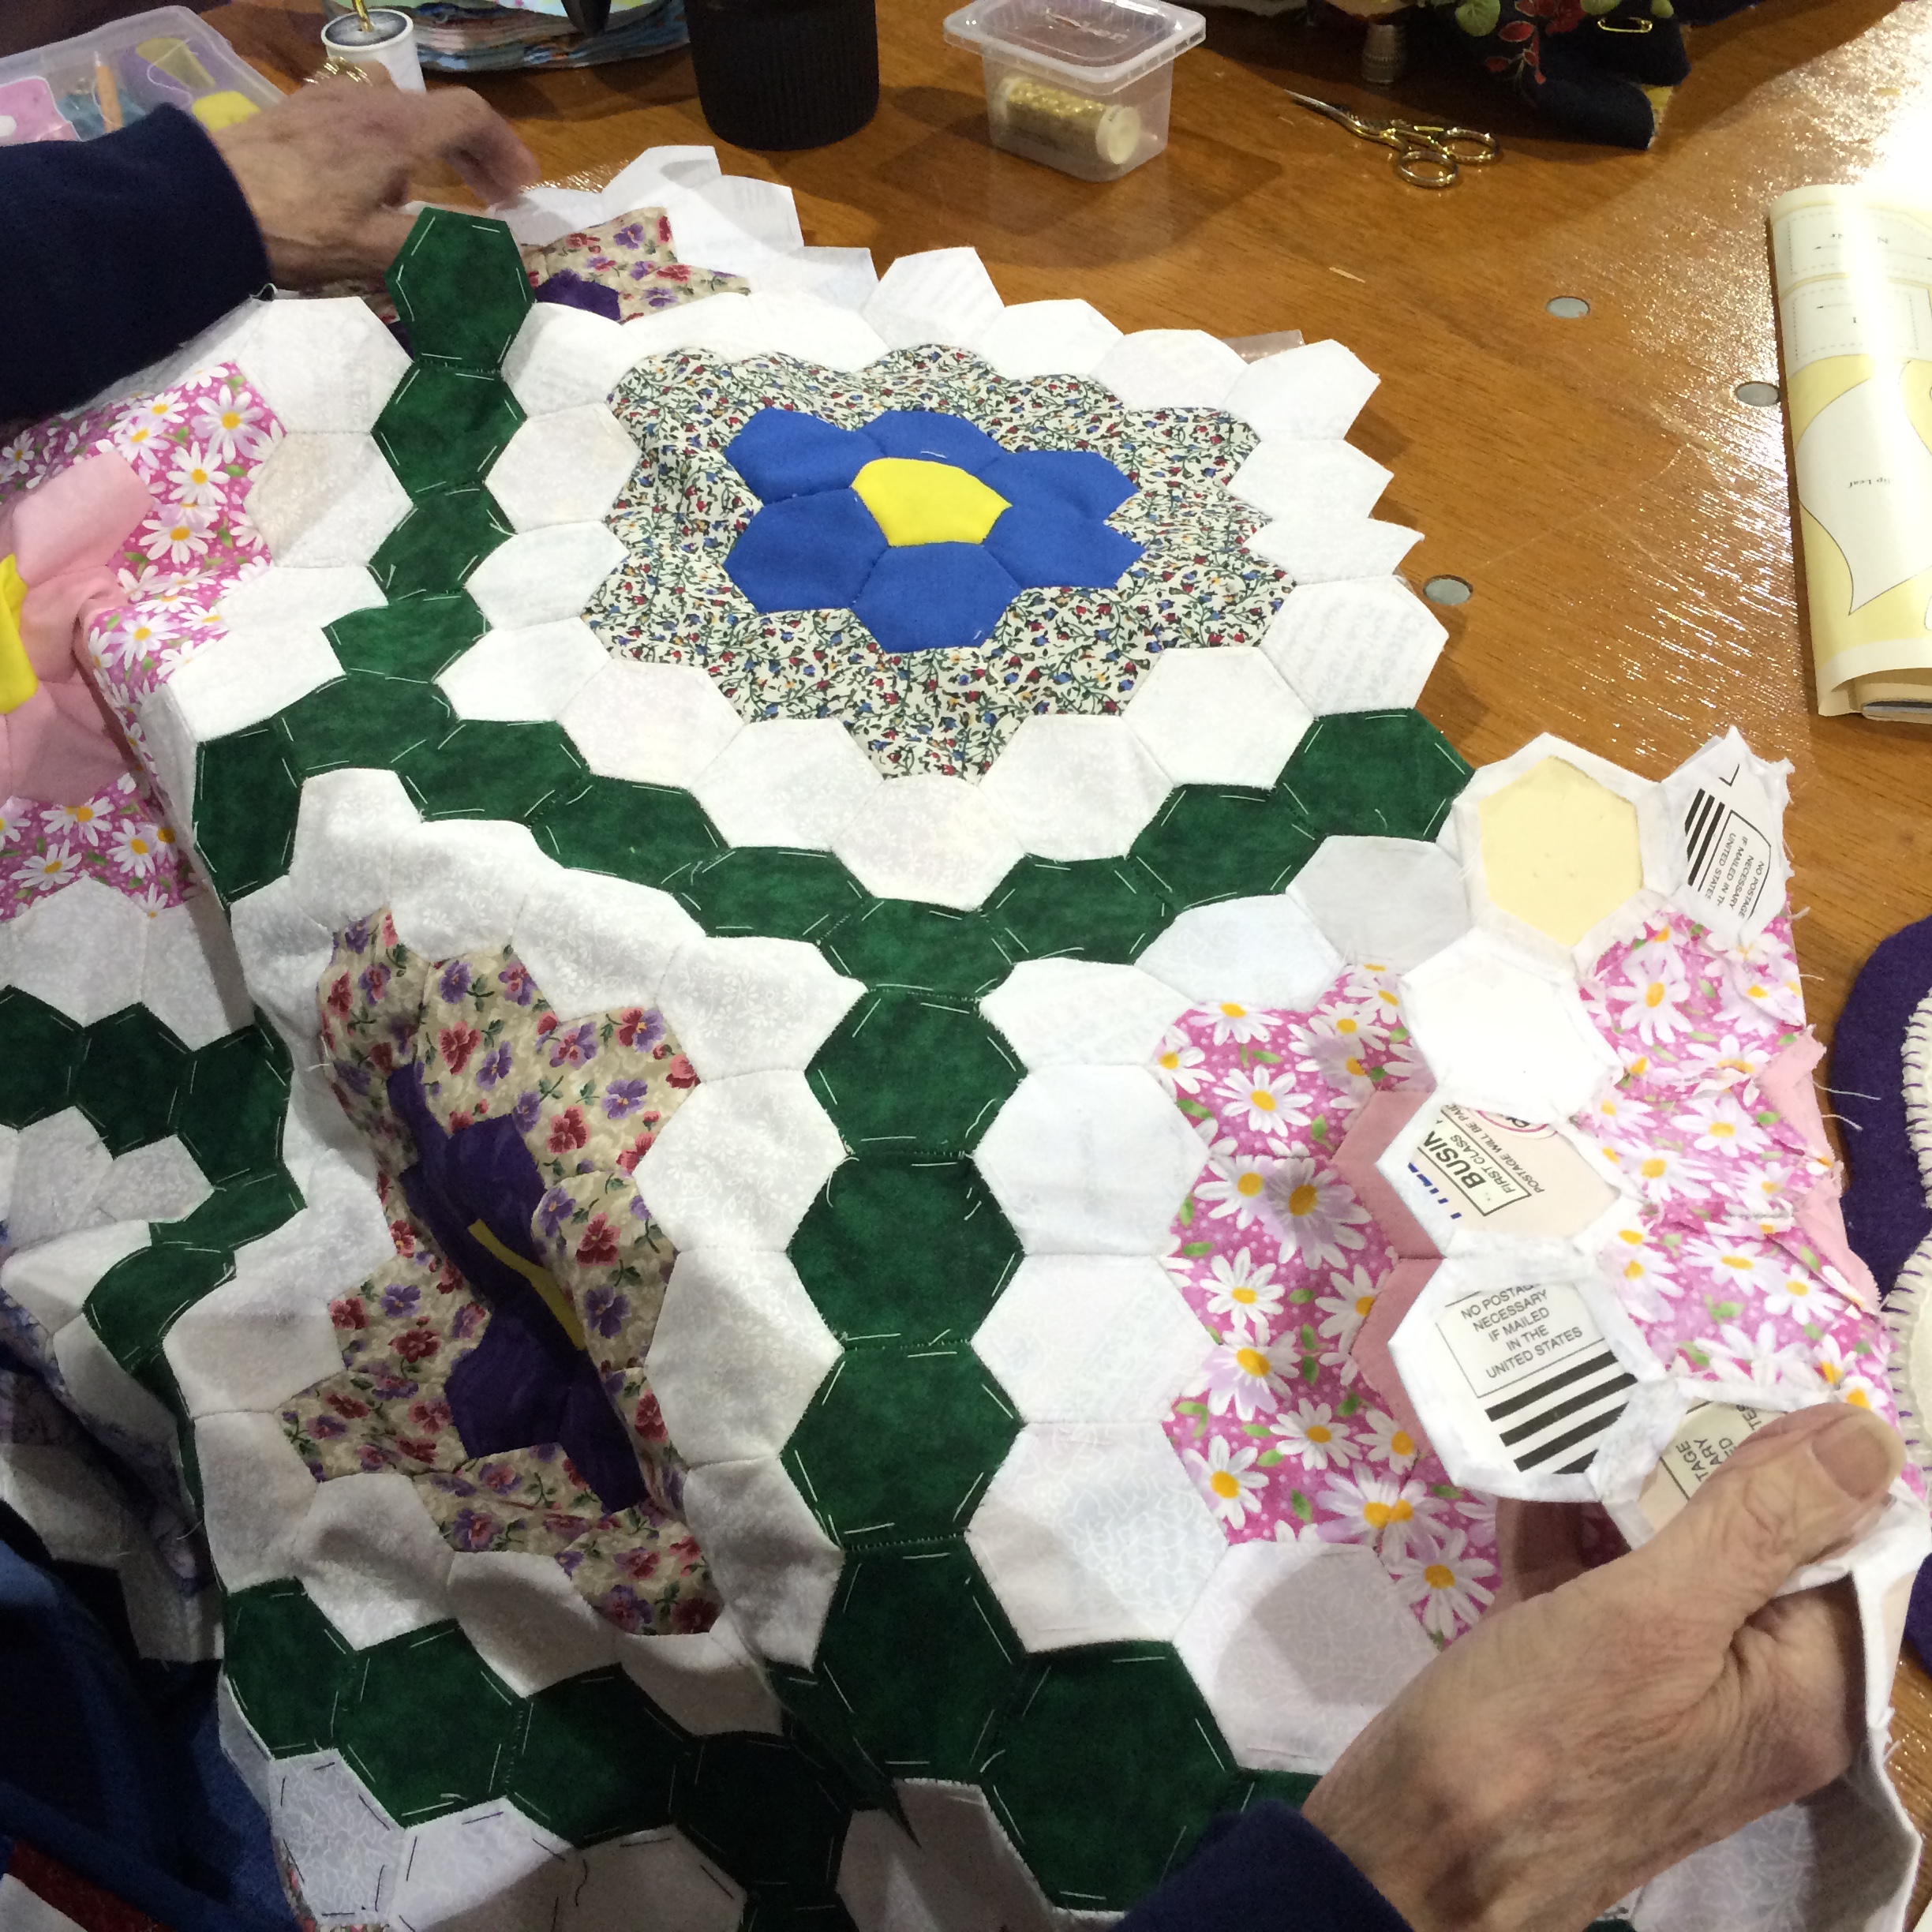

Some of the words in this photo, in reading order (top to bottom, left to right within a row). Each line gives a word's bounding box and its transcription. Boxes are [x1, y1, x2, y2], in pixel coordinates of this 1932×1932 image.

[1718, 833, 1736, 867] UNITED
[1741, 836, 1749, 846] IF
[1726, 846, 1745, 882] MAILED
[1755, 860, 1765, 875] NO
[1720, 882, 1730, 893] IN
[1728, 855, 1754, 910] NECESSARY
[1738, 876, 1759, 919] POSTAGE
[1465, 1121, 1483, 1133] BE
[1481, 1133, 1503, 1153] WILL
[1449, 1134, 1486, 1165] CLASS
[1481, 1166, 1516, 1194] FIRST
[1499, 1153, 1545, 1193] POSTAGE
[1459, 1304, 1481, 1320] NO
[1481, 1283, 1541, 1311] POSTA
[1472, 1289, 1548, 1332] NECESSARY
[1488, 1328, 1500, 1342] IF
[1502, 1307, 1550, 1336] MAILED
[1505, 1338, 1522, 1351] IN
[1520, 1324, 1550, 1343] THE
[1485, 1350, 1534, 1379] UNITED
[1534, 1326, 1583, 1357] STATES
